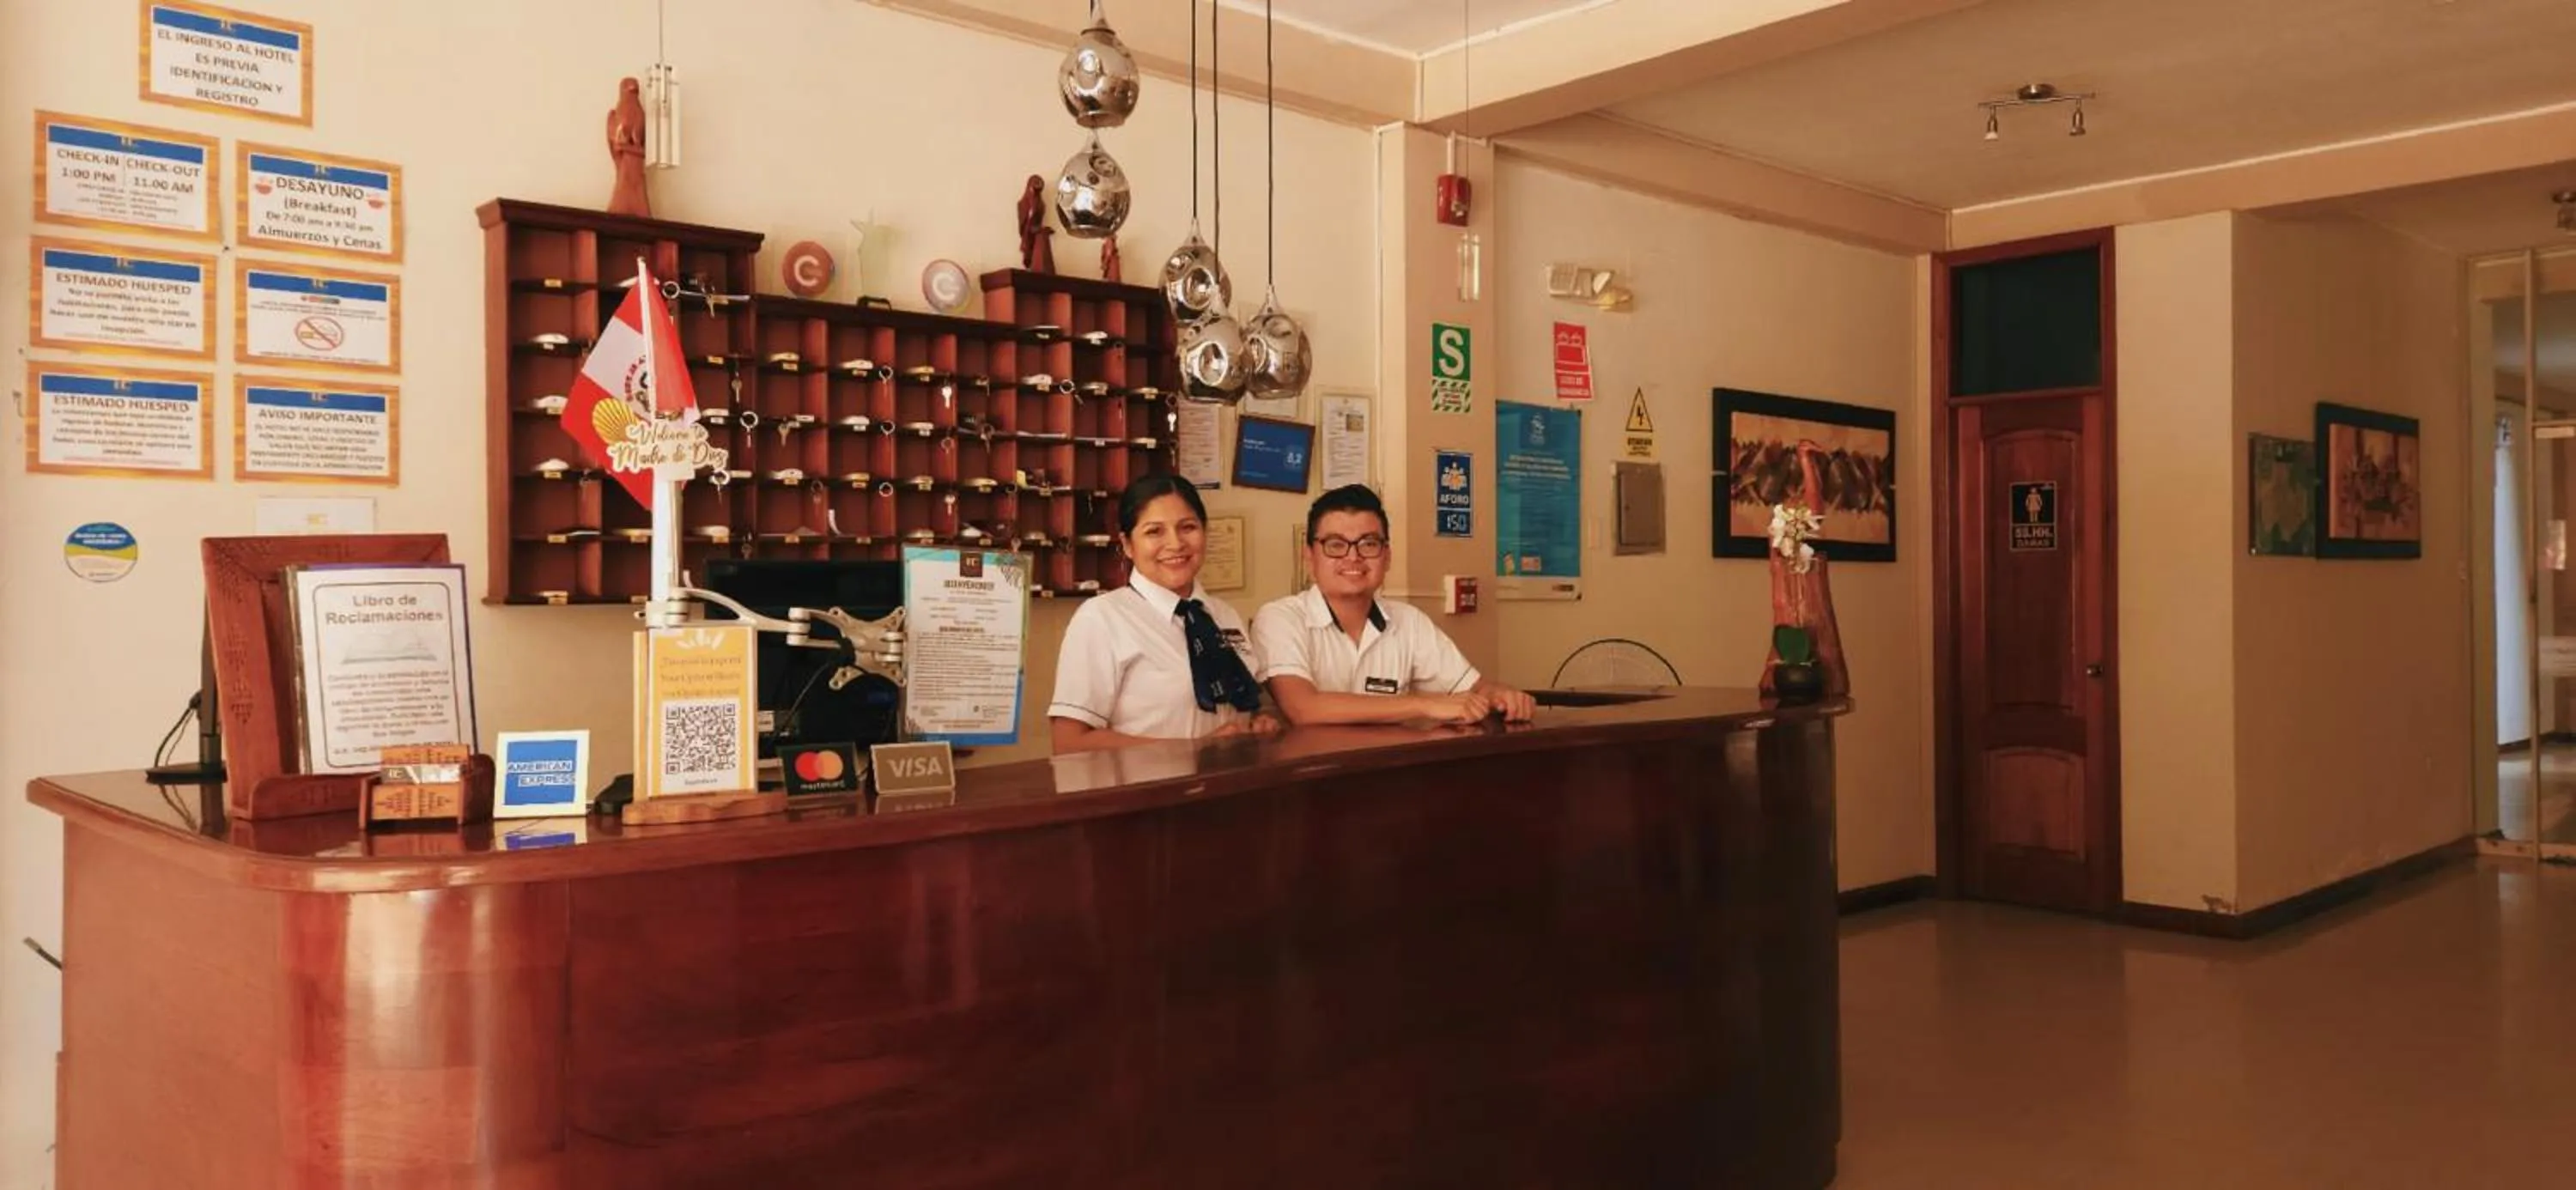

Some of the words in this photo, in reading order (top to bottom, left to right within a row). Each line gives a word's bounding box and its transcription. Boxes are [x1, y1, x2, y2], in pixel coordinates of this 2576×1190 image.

[158, 30, 172, 40] EL
[176, 33, 232, 52] INGRESO
[236, 44, 252, 55] AL
[255, 47, 294, 64] HOTEL
[195, 53, 210, 64] ES
[214, 56, 259, 73] PREVIA
[170, 66, 272, 92] IDENTIFICACION
[276, 85, 283, 94] Y
[196, 88, 258, 106] REGISTRO
[57, 149, 119, 167] CHECK-IN
[94, 168, 116, 182] PM
[172, 180, 194, 193] AM
[276, 177, 365, 200] DESAYUNO
[284, 197, 357, 218] (Breakfast)
[258, 224, 330, 243] Almuerzos
[333, 236, 340, 246] y
[343, 235, 382, 250] Cenas
[56, 272, 128, 289] ESTIMADO
[131, 279, 192, 295] HUESPED
[1439, 330, 1464, 376] S
[54, 395, 125, 410] ESTIMADO
[129, 398, 190, 413] HUESPED
[258, 409, 296, 420] AVISO
[300, 411, 377, 425] IMPORTANTE
[1440, 495, 1469, 505] AFORO
[353, 595, 394, 606] Libro
[398, 595, 417, 605] de
[325, 611, 443, 625] Reclamaciones
[507, 760, 572, 773] AMERICAN
[888, 756, 944, 778] VISA
[519, 774, 576, 786] EXPRESS
